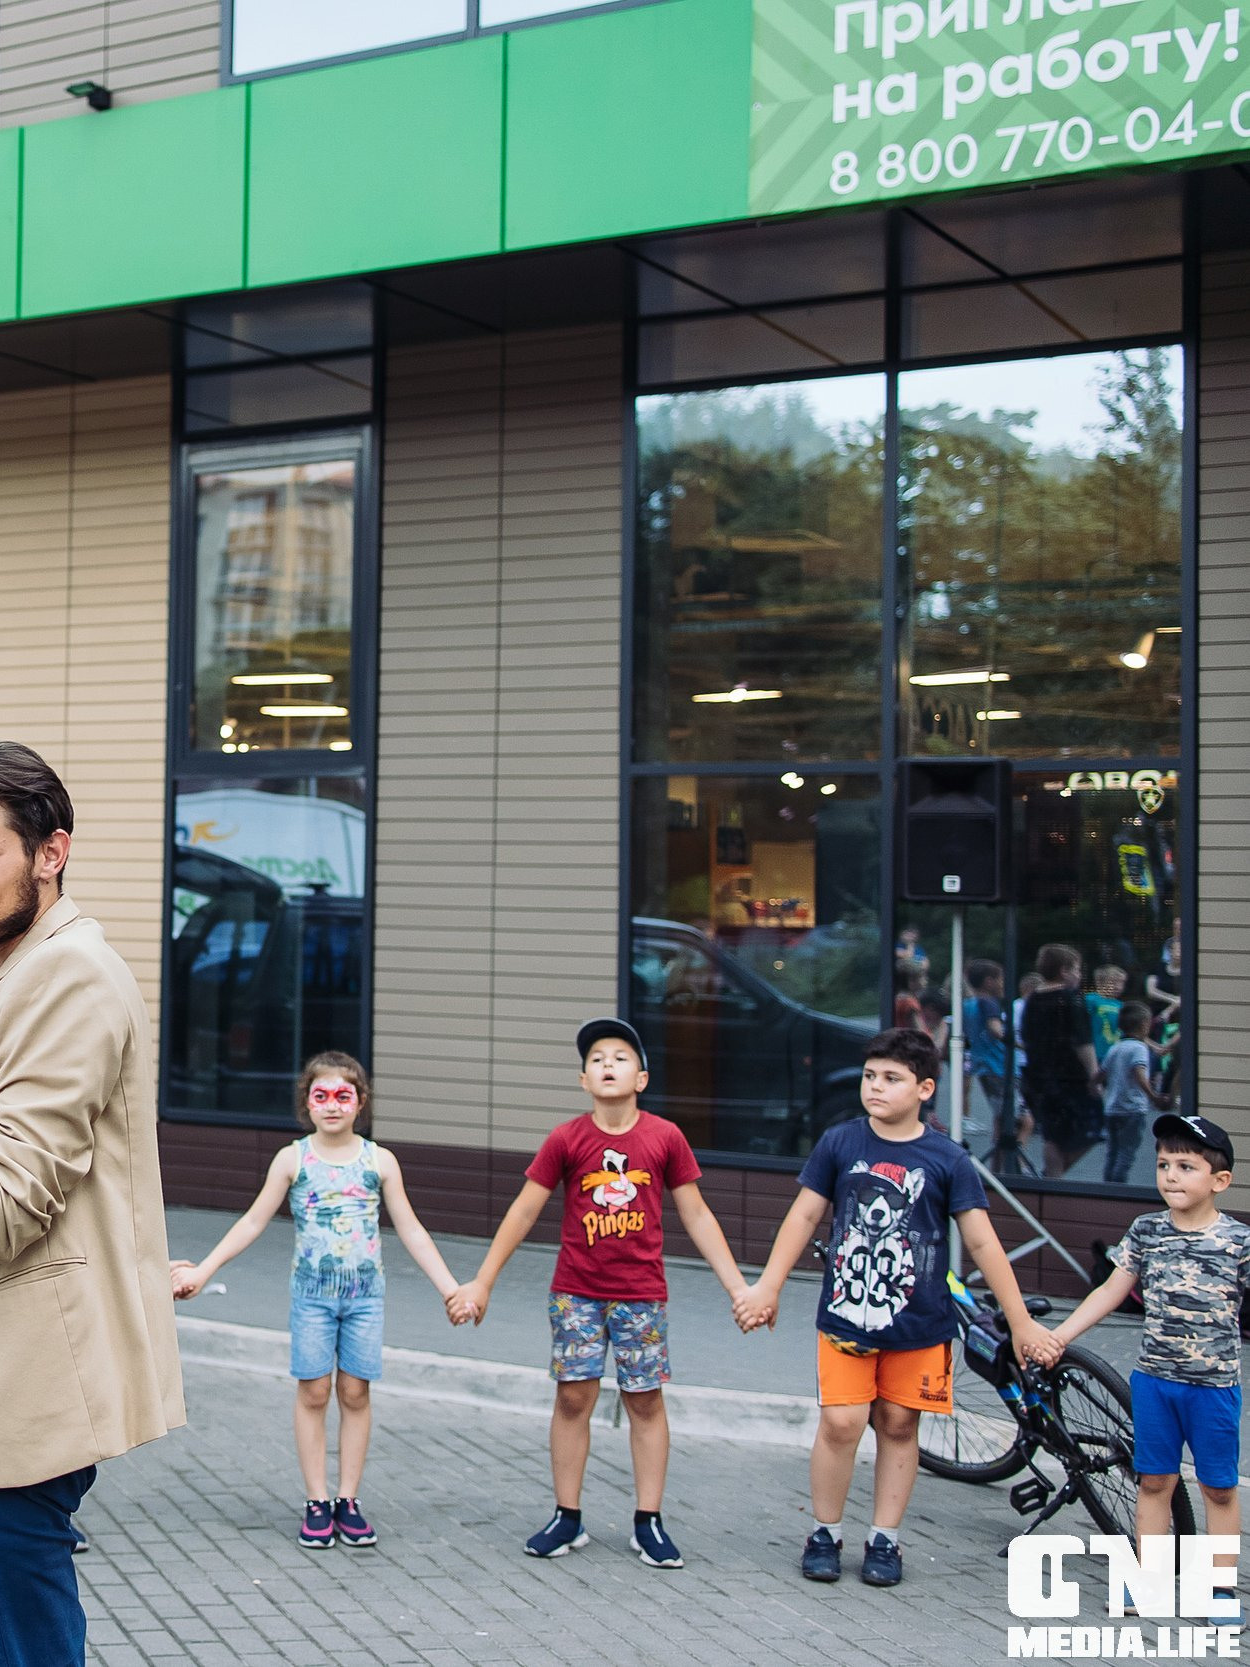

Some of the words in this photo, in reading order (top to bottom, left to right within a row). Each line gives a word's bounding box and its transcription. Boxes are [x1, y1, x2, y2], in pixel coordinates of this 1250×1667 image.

[832, 71, 917, 124] на
[942, 8, 1240, 121] работу!
[829, 150, 860, 195] 8
[876, 133, 978, 188] 800
[581, 1210, 646, 1248] Pingas
